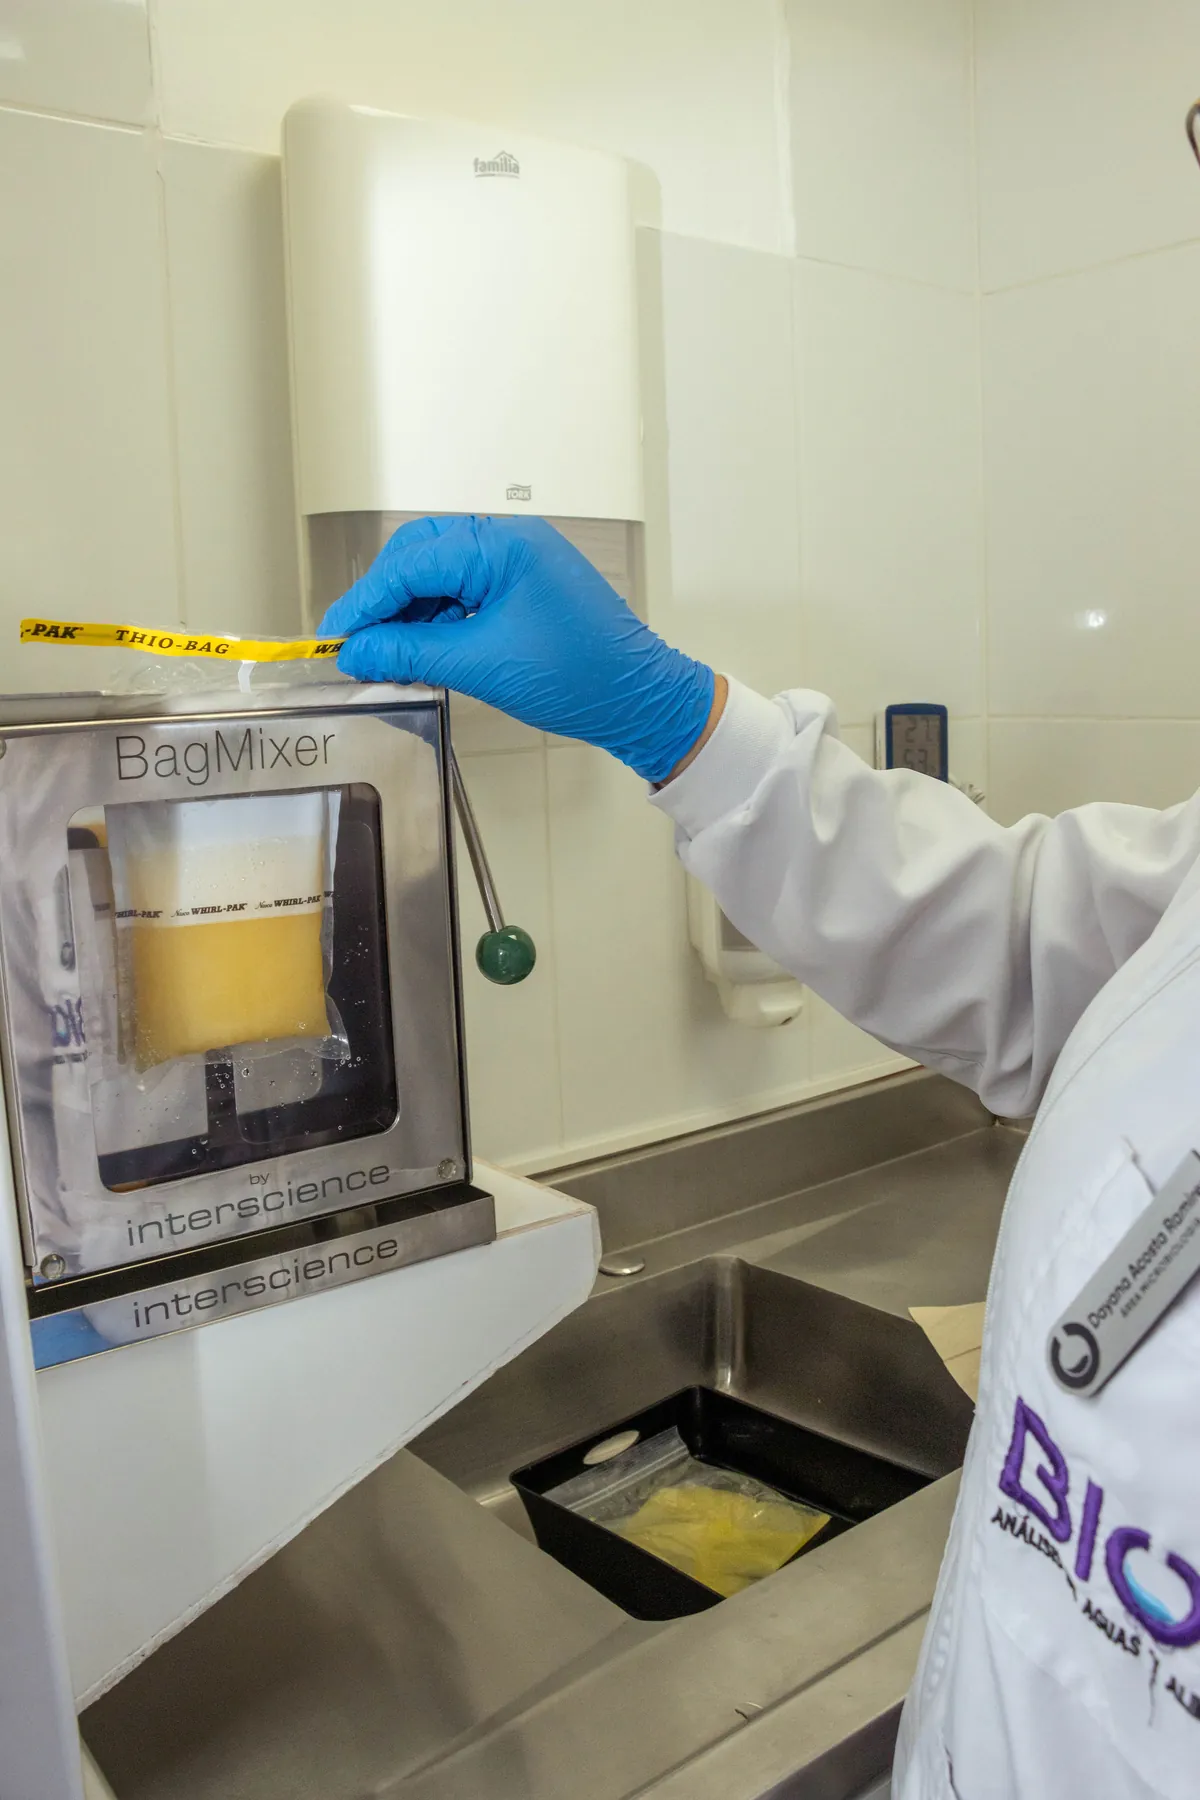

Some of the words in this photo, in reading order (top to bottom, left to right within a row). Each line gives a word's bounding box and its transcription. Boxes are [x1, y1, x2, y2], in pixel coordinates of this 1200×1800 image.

[473, 156, 520, 174] familia
[21, 623, 80, 640] -PAK
[115, 629, 231, 655] THIO-BAG
[115, 727, 335, 786] BagMixer
[191, 902, 246, 916] WHIRL-PAK
[274, 894, 321, 907] WHIRL-PAK
[126, 1164, 391, 1247] interscience
[249, 1172, 270, 1186] by
[133, 1238, 399, 1328] interscience
[1087, 1276, 1132, 1330] Dayana
[1128, 1231, 1168, 1280] Acosta
[1082, 1598, 1141, 1657] AGUAS
